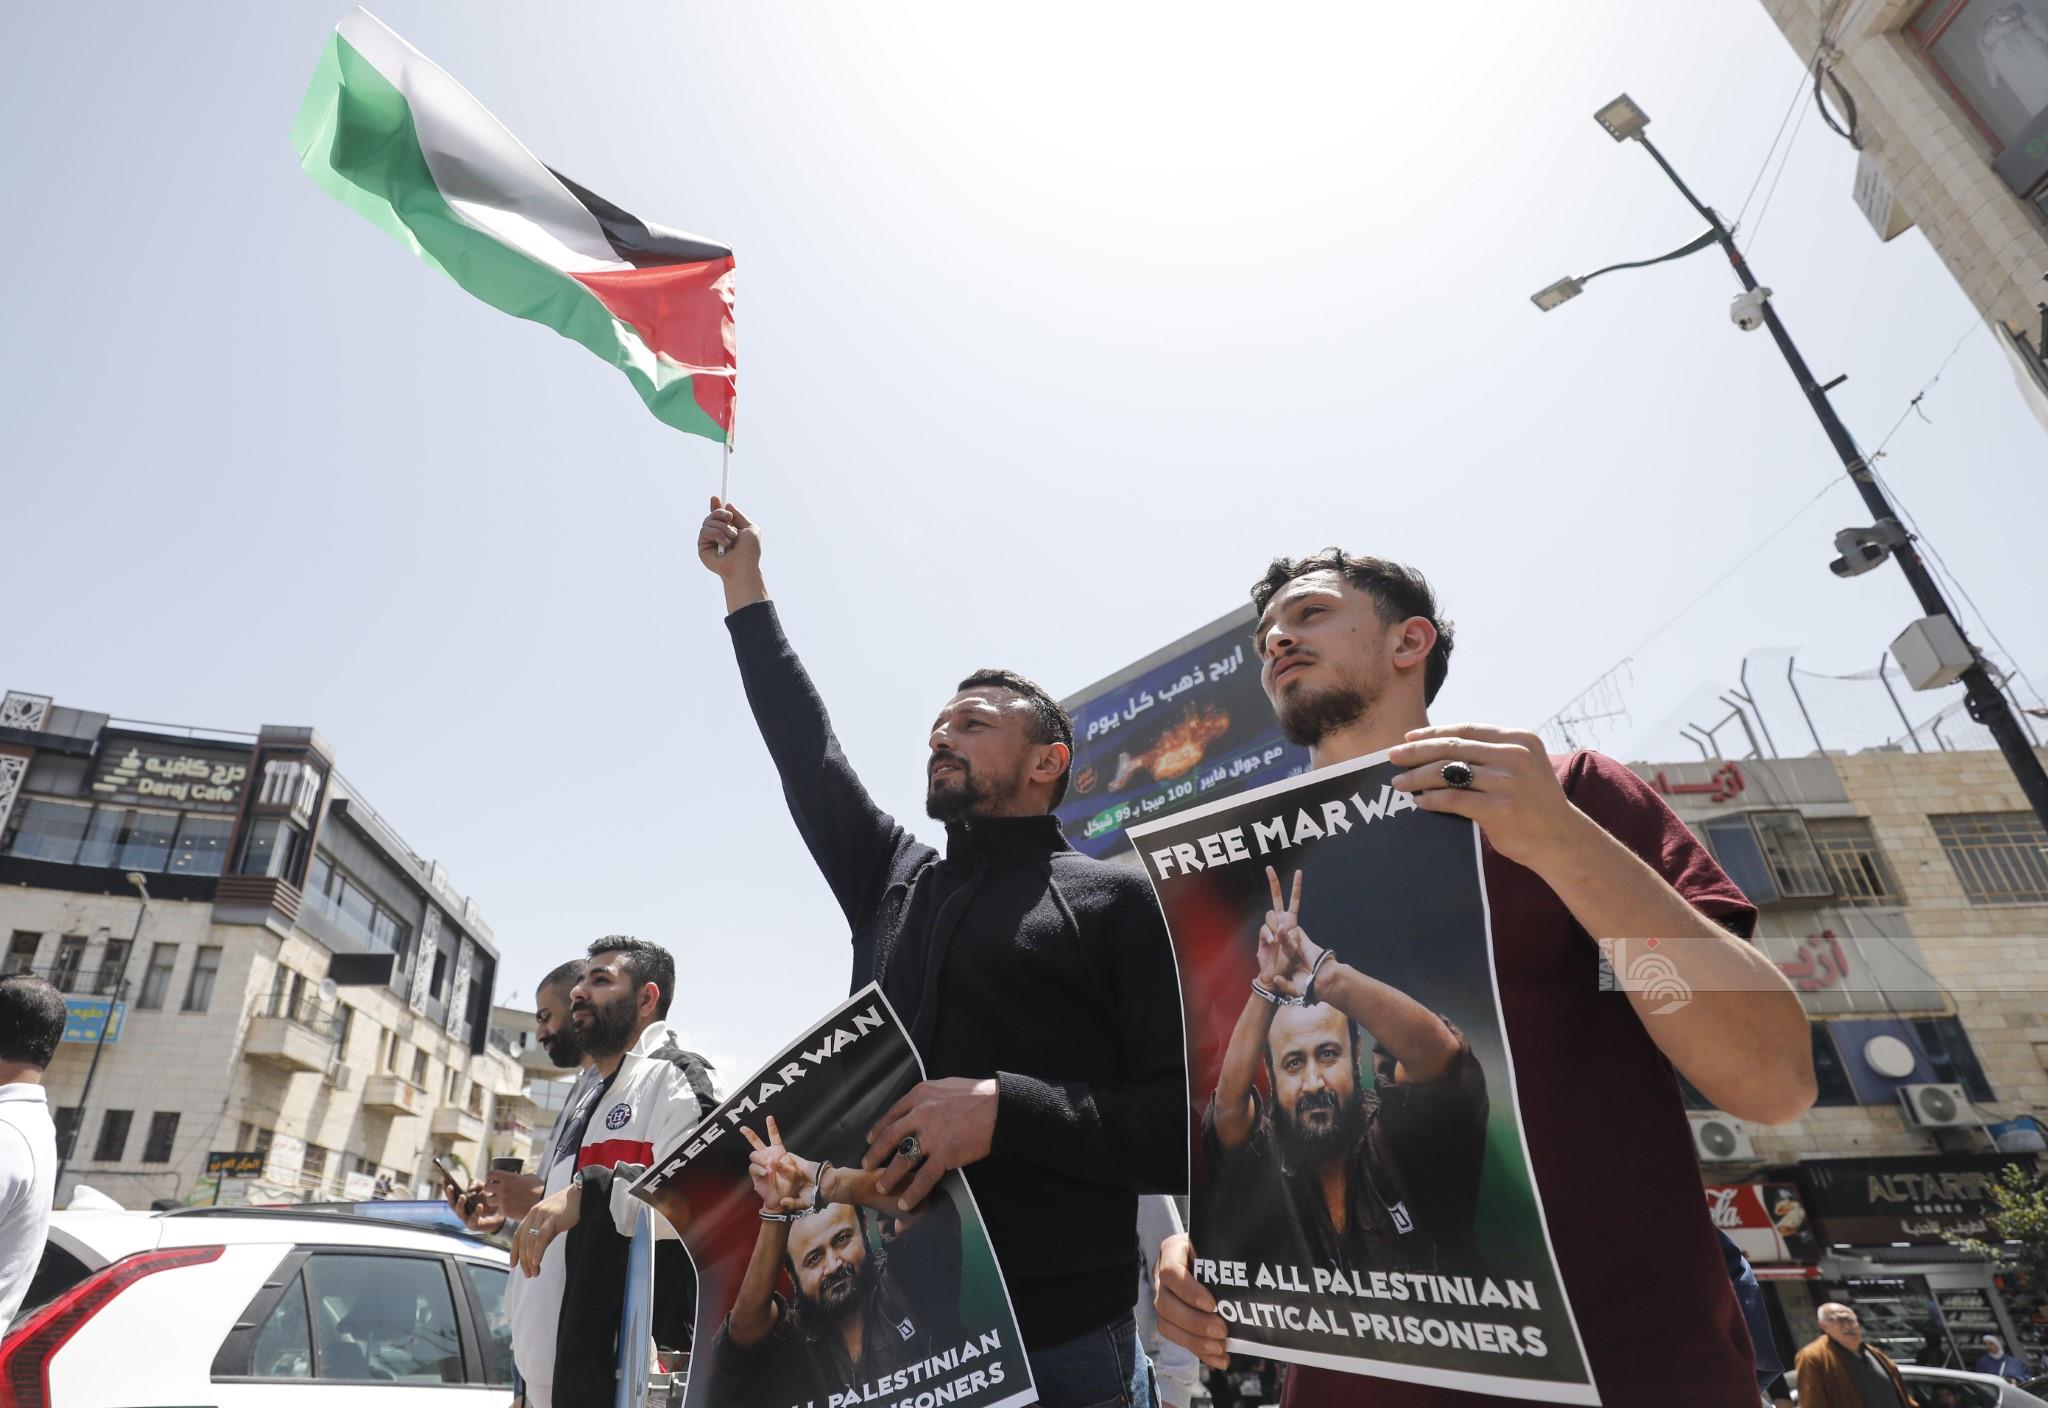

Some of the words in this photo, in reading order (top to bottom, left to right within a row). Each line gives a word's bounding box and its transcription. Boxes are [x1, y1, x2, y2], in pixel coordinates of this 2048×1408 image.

[1209, 645, 1244, 681] اربح
[1158, 667, 1205, 702] ذهب
[1123, 692, 1154, 720] كل
[1086, 711, 1119, 741] يوم
[144, 756, 210, 778] كافيه
[1230, 754, 1261, 778] جوال
[1264, 746, 1283, 766] مع
[138, 778, 190, 800] Daraj
[210, 765, 246, 785] درج
[1199, 769, 1227, 791] فايبر
[1141, 793, 1165, 813] ميجا
[1167, 781, 1192, 802] 100
[1083, 814, 1113, 837] شيكل
[1150, 826, 1251, 880] FREE
[1251, 784, 1418, 855] MARWA
[642, 1122, 726, 1194] FREE
[725, 1004, 886, 1126] MARWAN
[1193, 1258, 1249, 1288] FREE
[1254, 1262, 1309, 1294] ALL
[1312, 1267, 1541, 1310] PALESTINIAN
[1212, 1299, 1349, 1337] OLITICAL
[1350, 1311, 1548, 1357] PRISONERS
[828, 1328, 1002, 1408] PALESTINIAN
[889, 1362, 1006, 1408] SONERS
